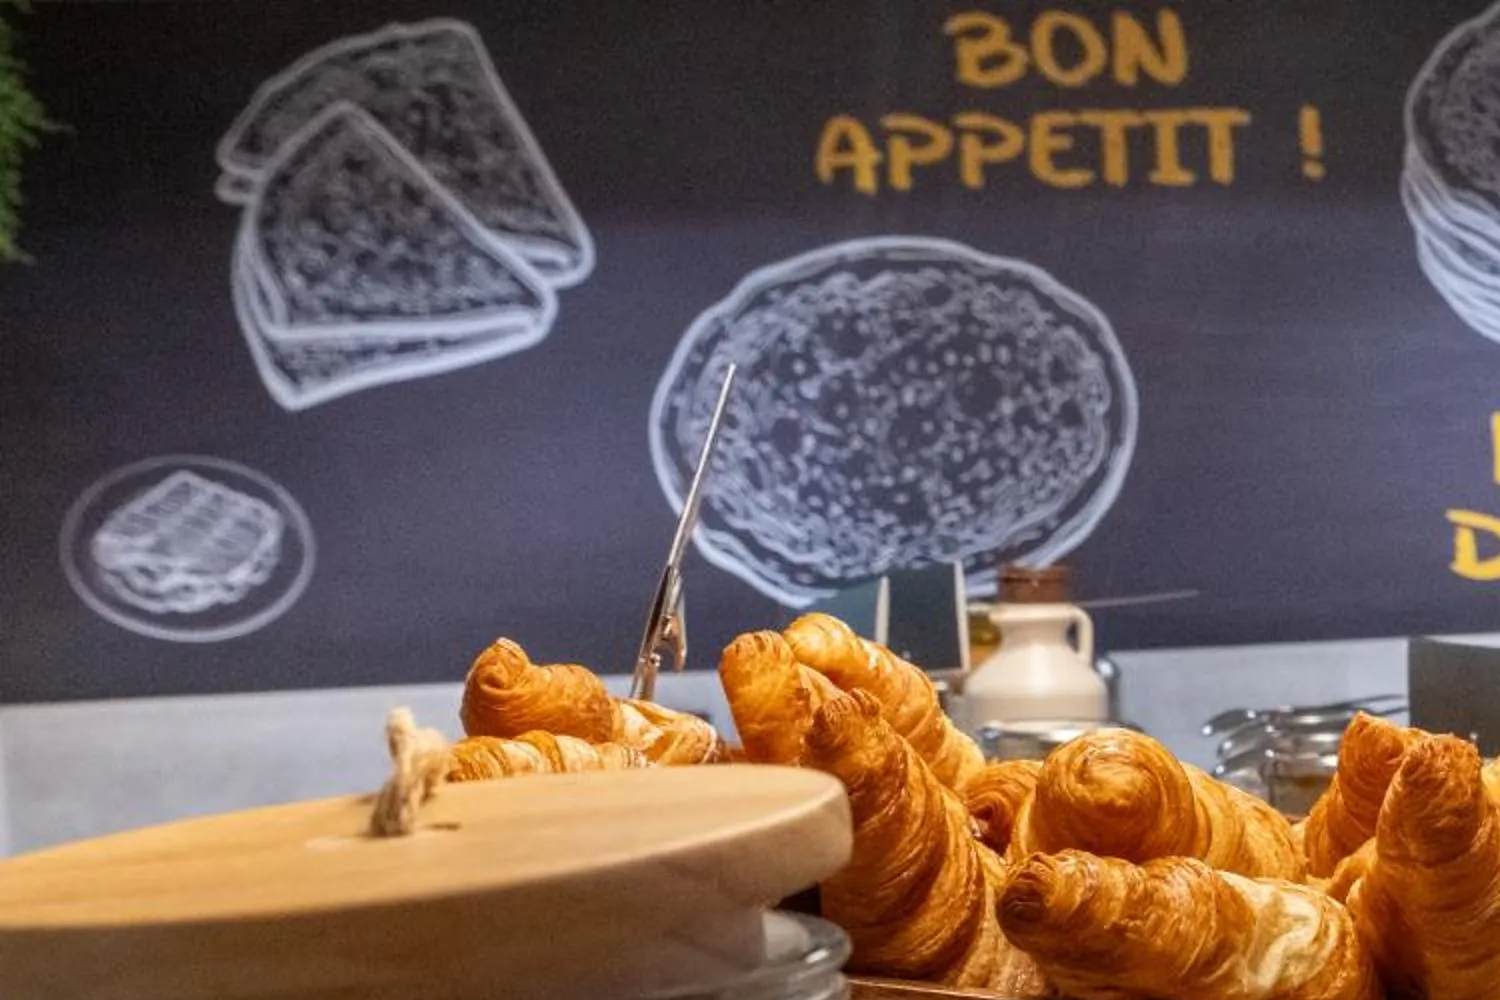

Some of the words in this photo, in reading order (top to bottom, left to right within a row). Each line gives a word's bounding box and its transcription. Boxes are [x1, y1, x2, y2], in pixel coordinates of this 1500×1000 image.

[943, 10, 1188, 87] BON
[816, 107, 1249, 195] APPETIT
[1299, 105, 1324, 180] !
